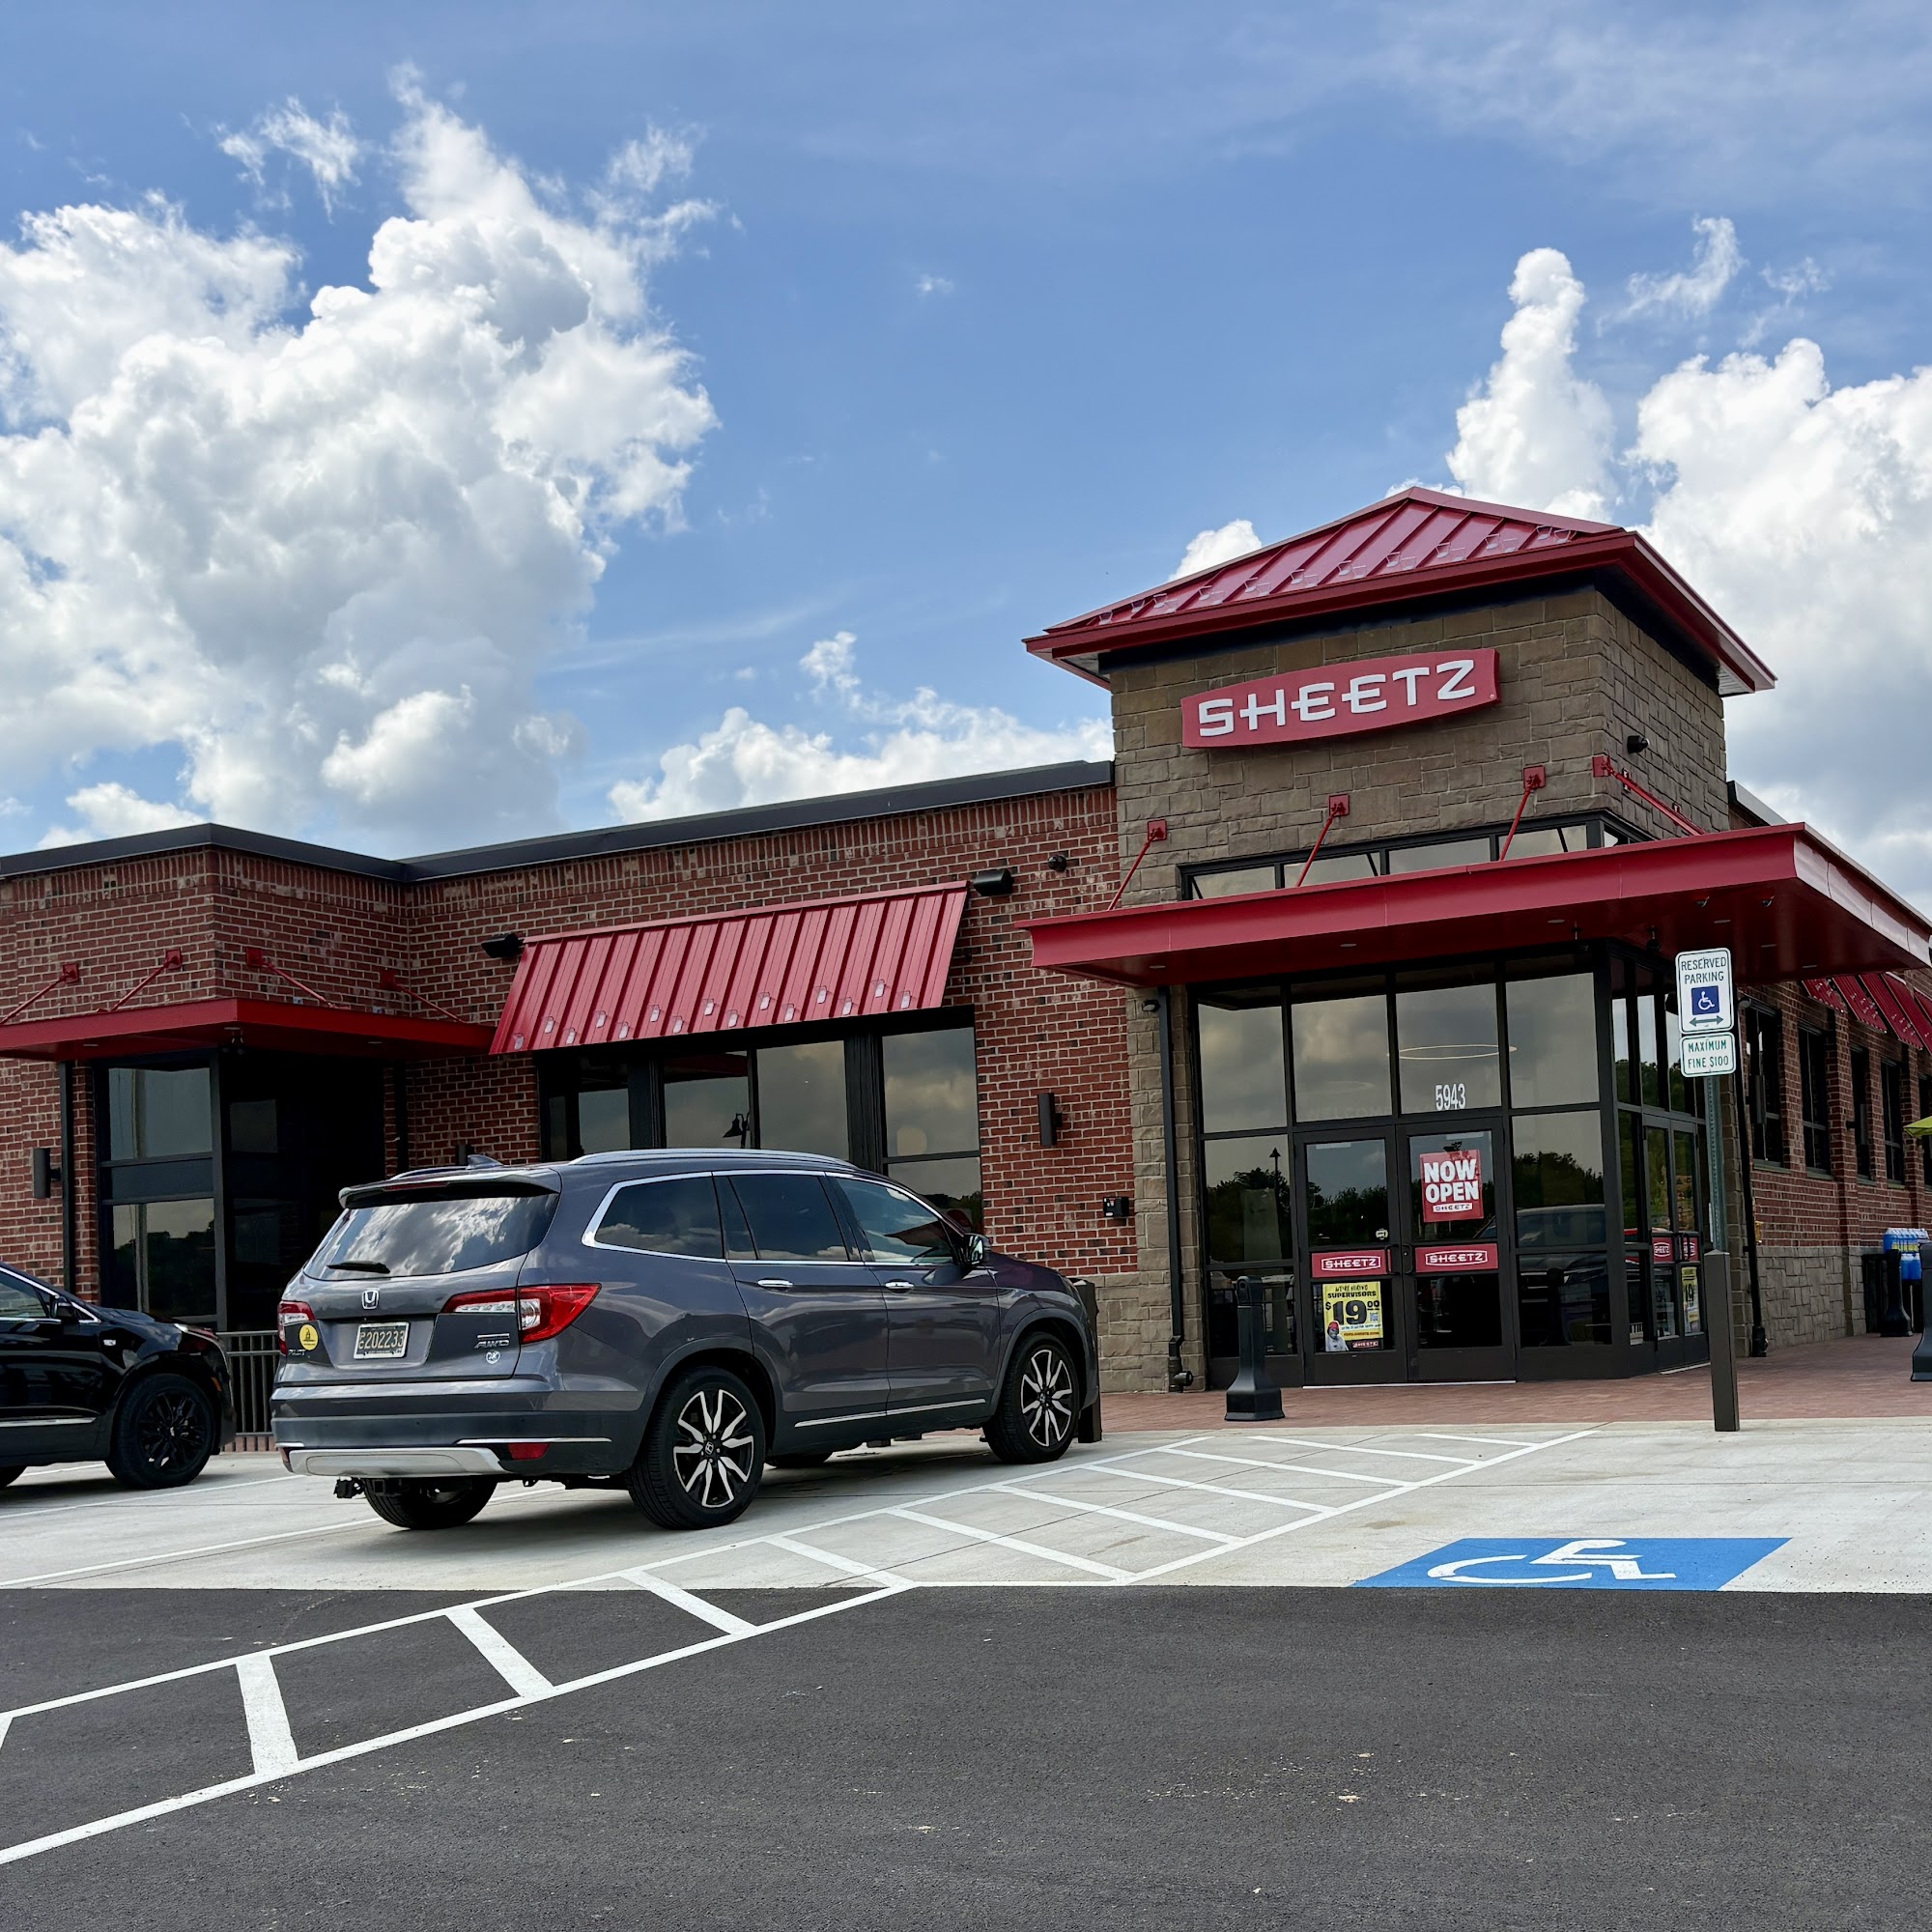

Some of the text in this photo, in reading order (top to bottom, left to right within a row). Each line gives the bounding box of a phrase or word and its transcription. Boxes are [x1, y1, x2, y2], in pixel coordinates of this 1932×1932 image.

[1198, 659, 1476, 737] SHEETZ
[1681, 957, 1727, 971] RESERVED
[1685, 971, 1724, 984] PARKING
[1688, 1039, 1727, 1052] MAXIMUM
[1688, 1055, 1729, 1068] FINE $100
[1435, 1083, 1466, 1111] 5943
[1424, 1159, 1476, 1183] NOW
[1425, 1180, 1479, 1204] OPEN
[1324, 1258, 1378, 1268] SHEETZ
[1429, 1253, 1484, 1264] SHEETZ
